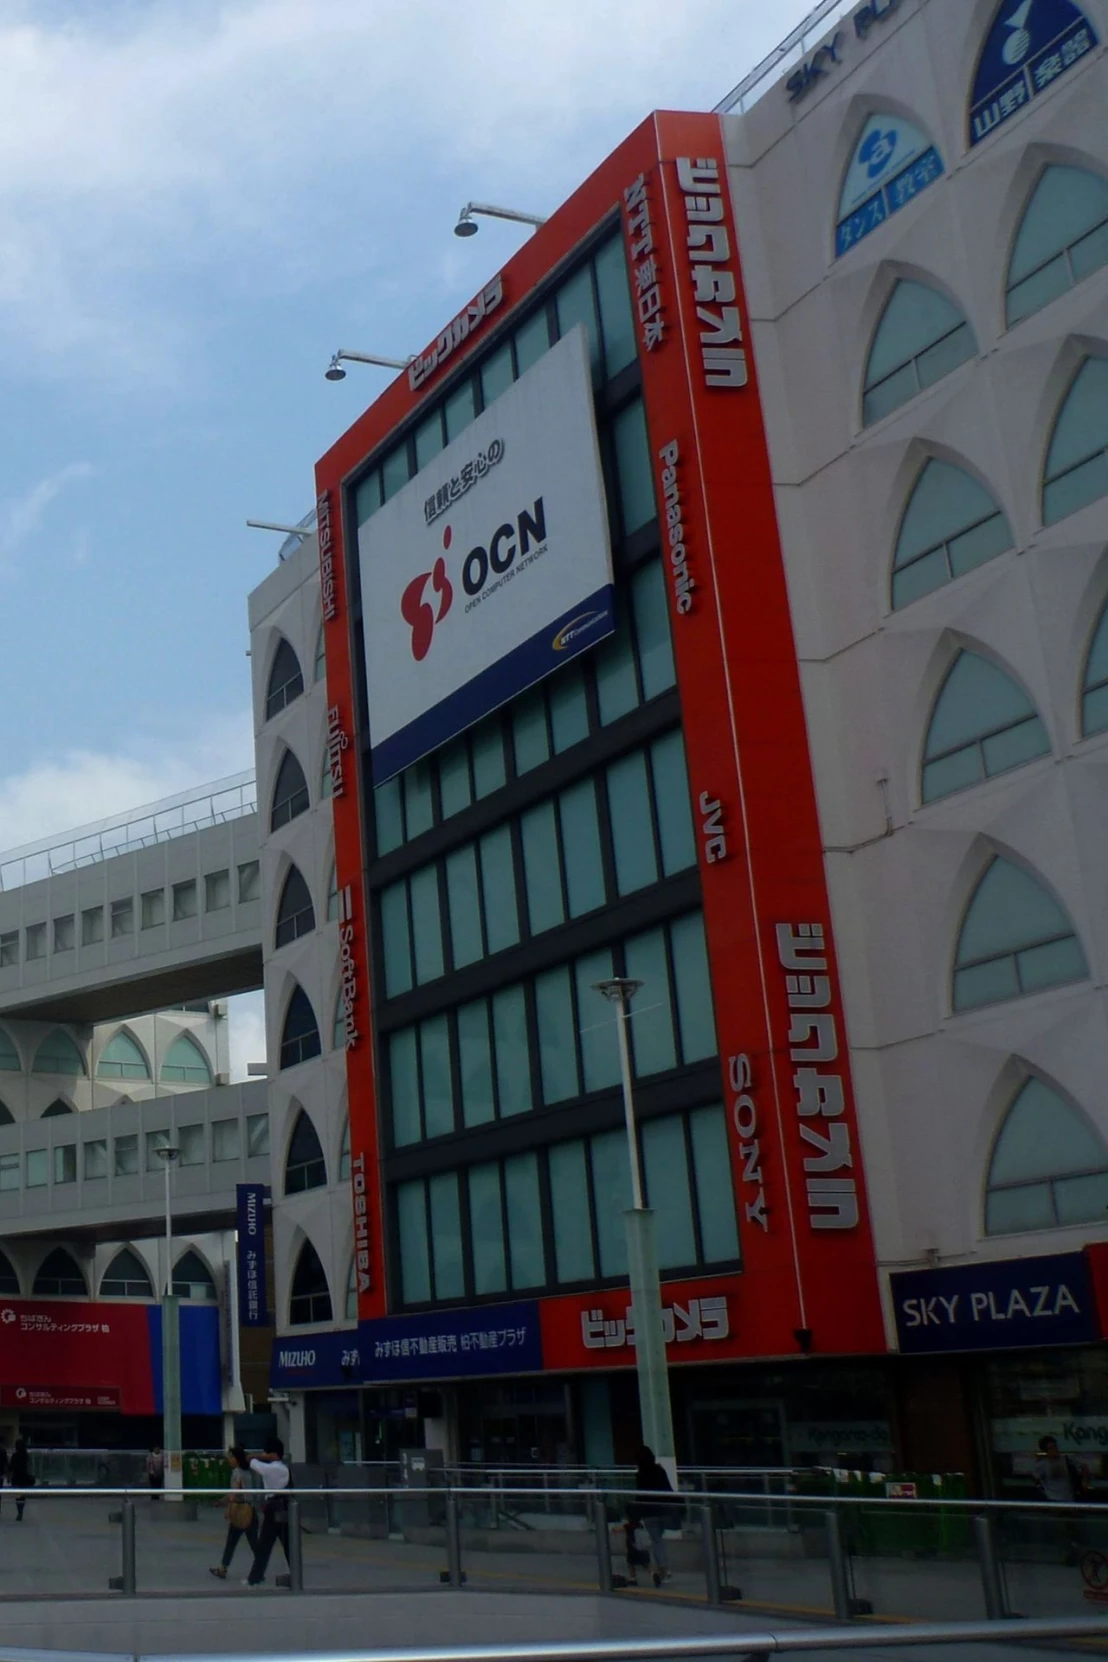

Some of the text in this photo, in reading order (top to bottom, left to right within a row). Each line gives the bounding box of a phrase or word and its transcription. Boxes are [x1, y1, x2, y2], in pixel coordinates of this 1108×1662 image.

[786, 31, 844, 103] SKY
[973, 27, 1092, 138] 山野楽器
[676, 156, 748, 388] ビックカメラ
[407, 274, 503, 392] ビックカメラ
[424, 438, 505, 525] 信頼と安心の
[659, 439, 695, 615] Panasonic
[317, 490, 335, 621] MITSUBISHI
[462, 495, 547, 596] OCN
[464, 544, 548, 614] OPEN COMPUTER NETWORK
[699, 790, 727, 864] JVC
[340, 924, 360, 1050] SoftBank
[775, 923, 859, 1229] ビックカメラ
[729, 1053, 768, 1233] SONY
[246, 1192, 259, 1320] MIZUHO みずほ信託銀行
[353, 1151, 371, 1293] TOSHIBA
[278, 1348, 360, 1368] MIZUHO みず
[374, 1326, 527, 1358] みずほ信不動産販売 柏不動産プラザ
[902, 1284, 1081, 1327] SKY PLAZA
